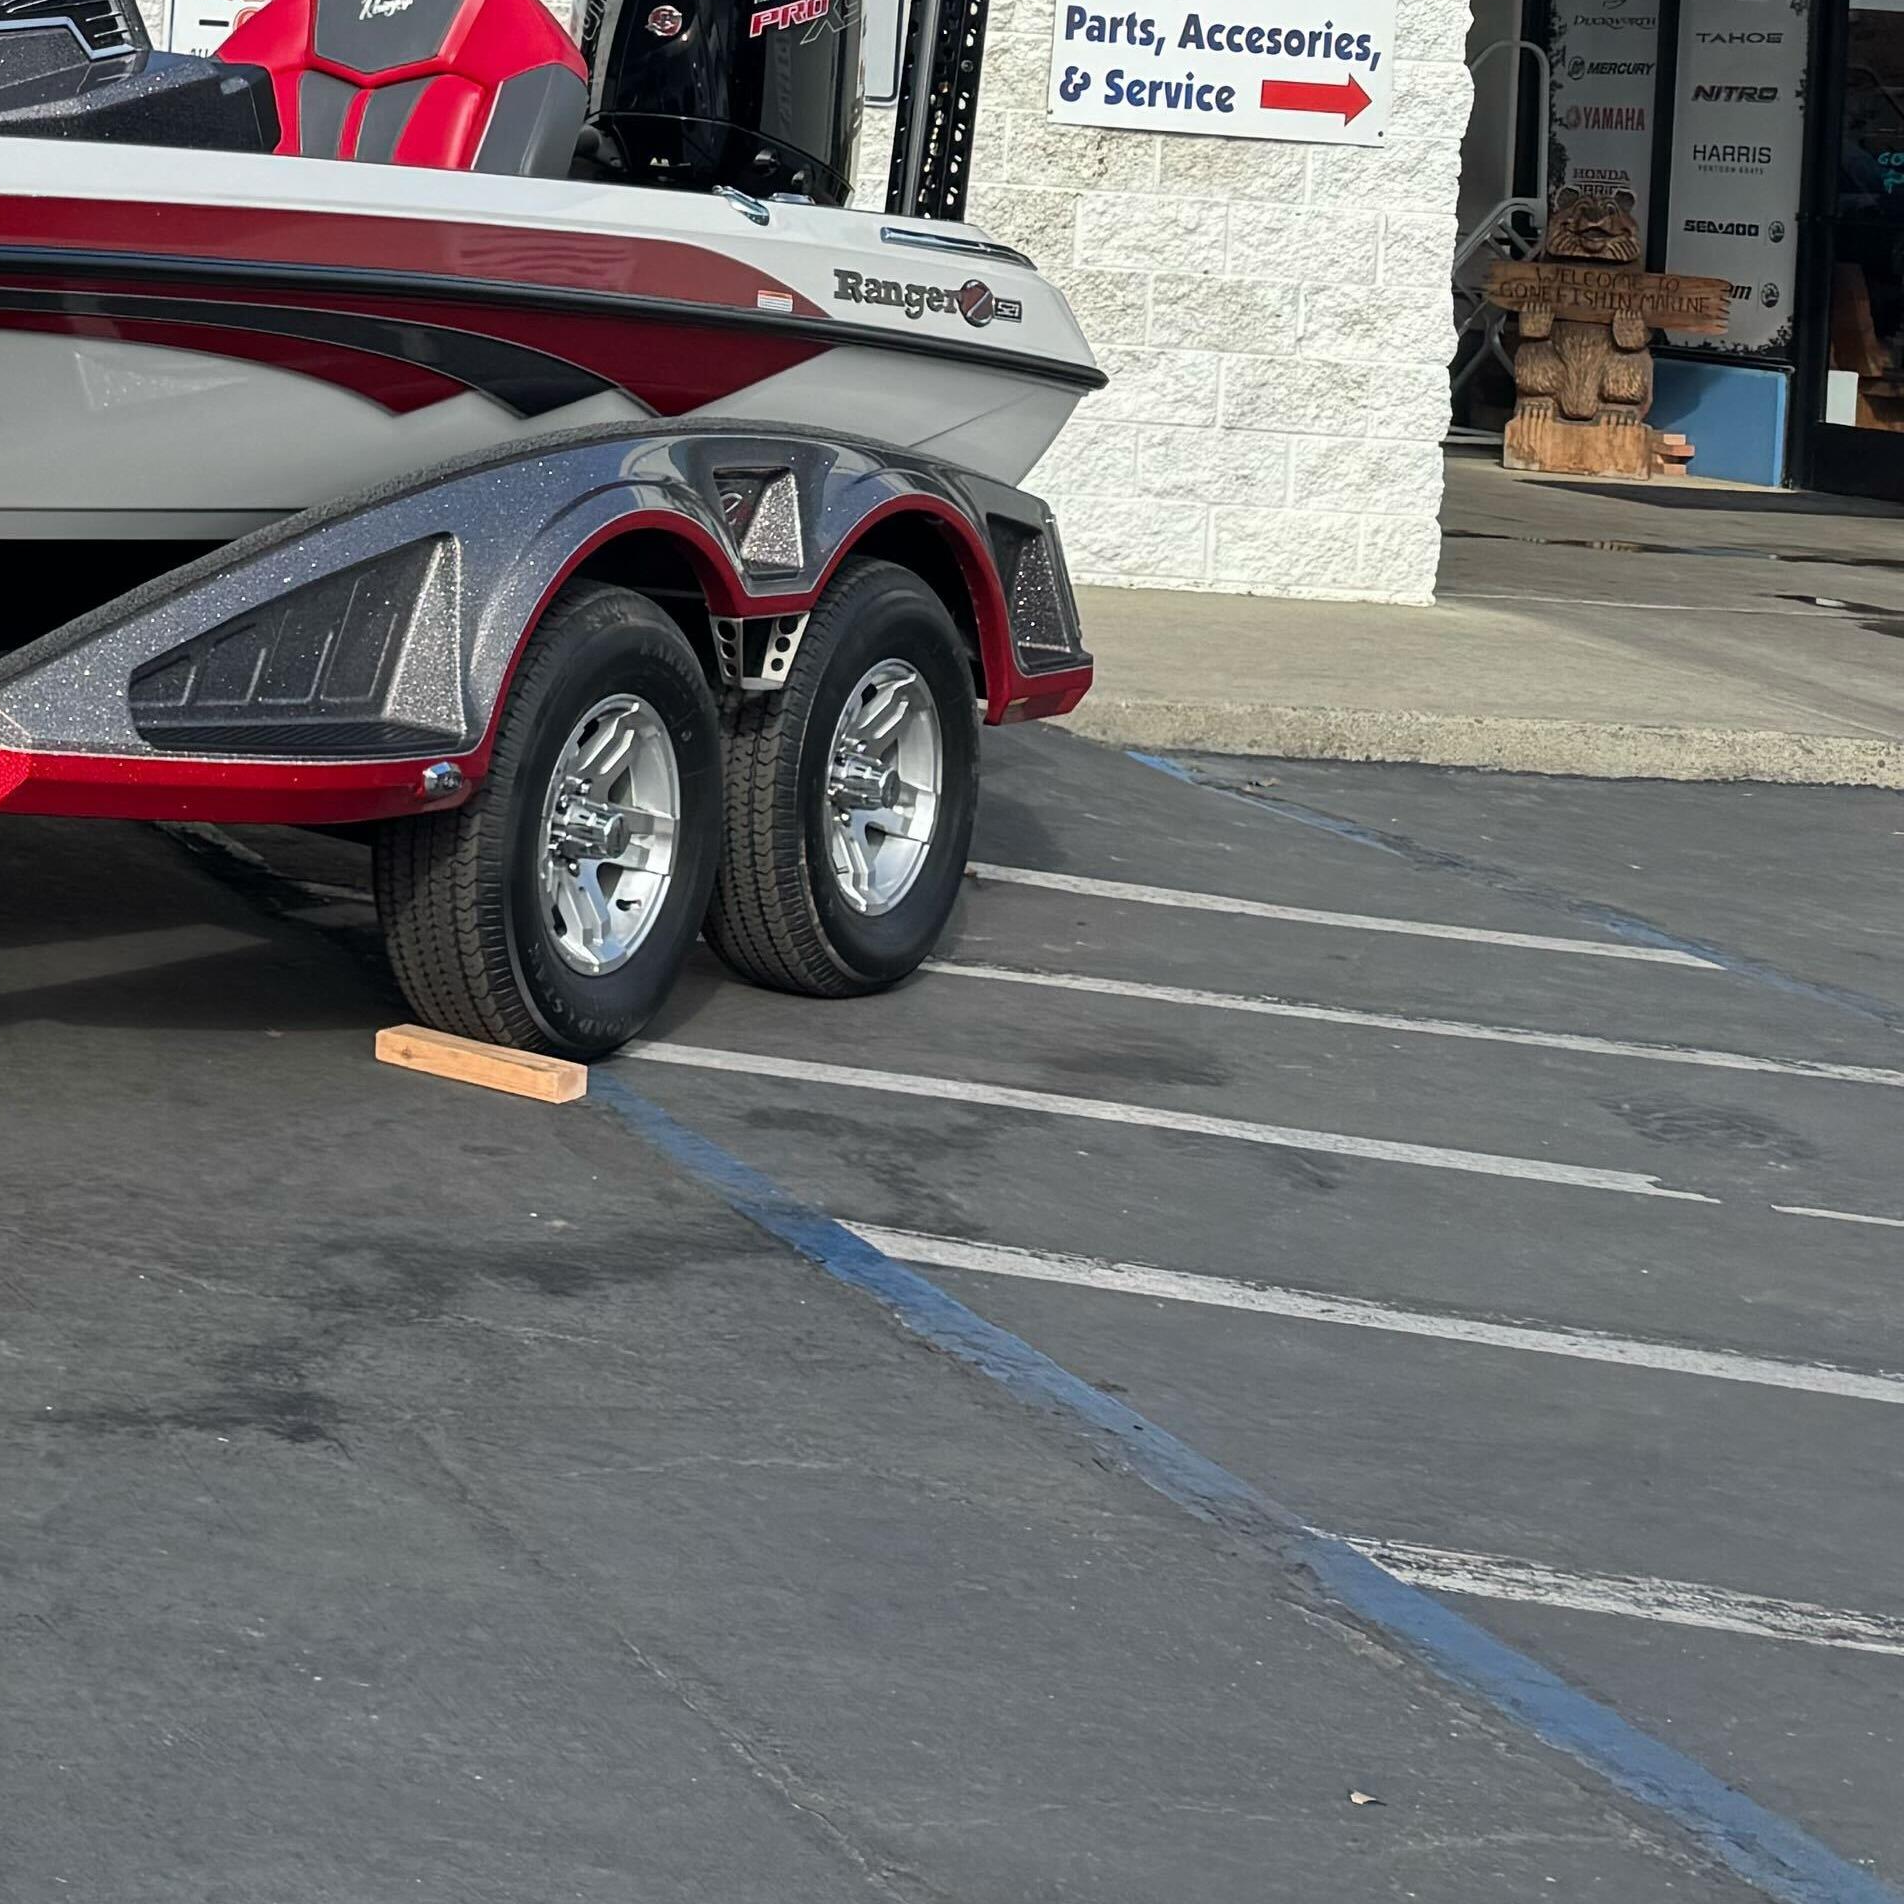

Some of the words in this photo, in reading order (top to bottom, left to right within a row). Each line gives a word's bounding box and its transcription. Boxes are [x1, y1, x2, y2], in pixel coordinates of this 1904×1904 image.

[1065, 5, 1166, 56] Parts,
[1177, 13, 1381, 72] Accesories,
[1696, 33, 1784, 44] TAHOE
[1587, 62, 1655, 75] MERCURY
[1059, 66, 1091, 102] &
[1104, 69, 1236, 113] Service
[1691, 85, 1779, 103] NITRO
[1583, 106, 1646, 131] YAMAHA
[1693, 144, 1771, 164] HARRIS
[1572, 168, 1630, 181] HONDA
[1536, 267, 1643, 292] WELCOME
[1658, 276, 1681, 293] TO
[833, 268, 961, 319] Ranger
[1640, 294, 1712, 314] MARINE
